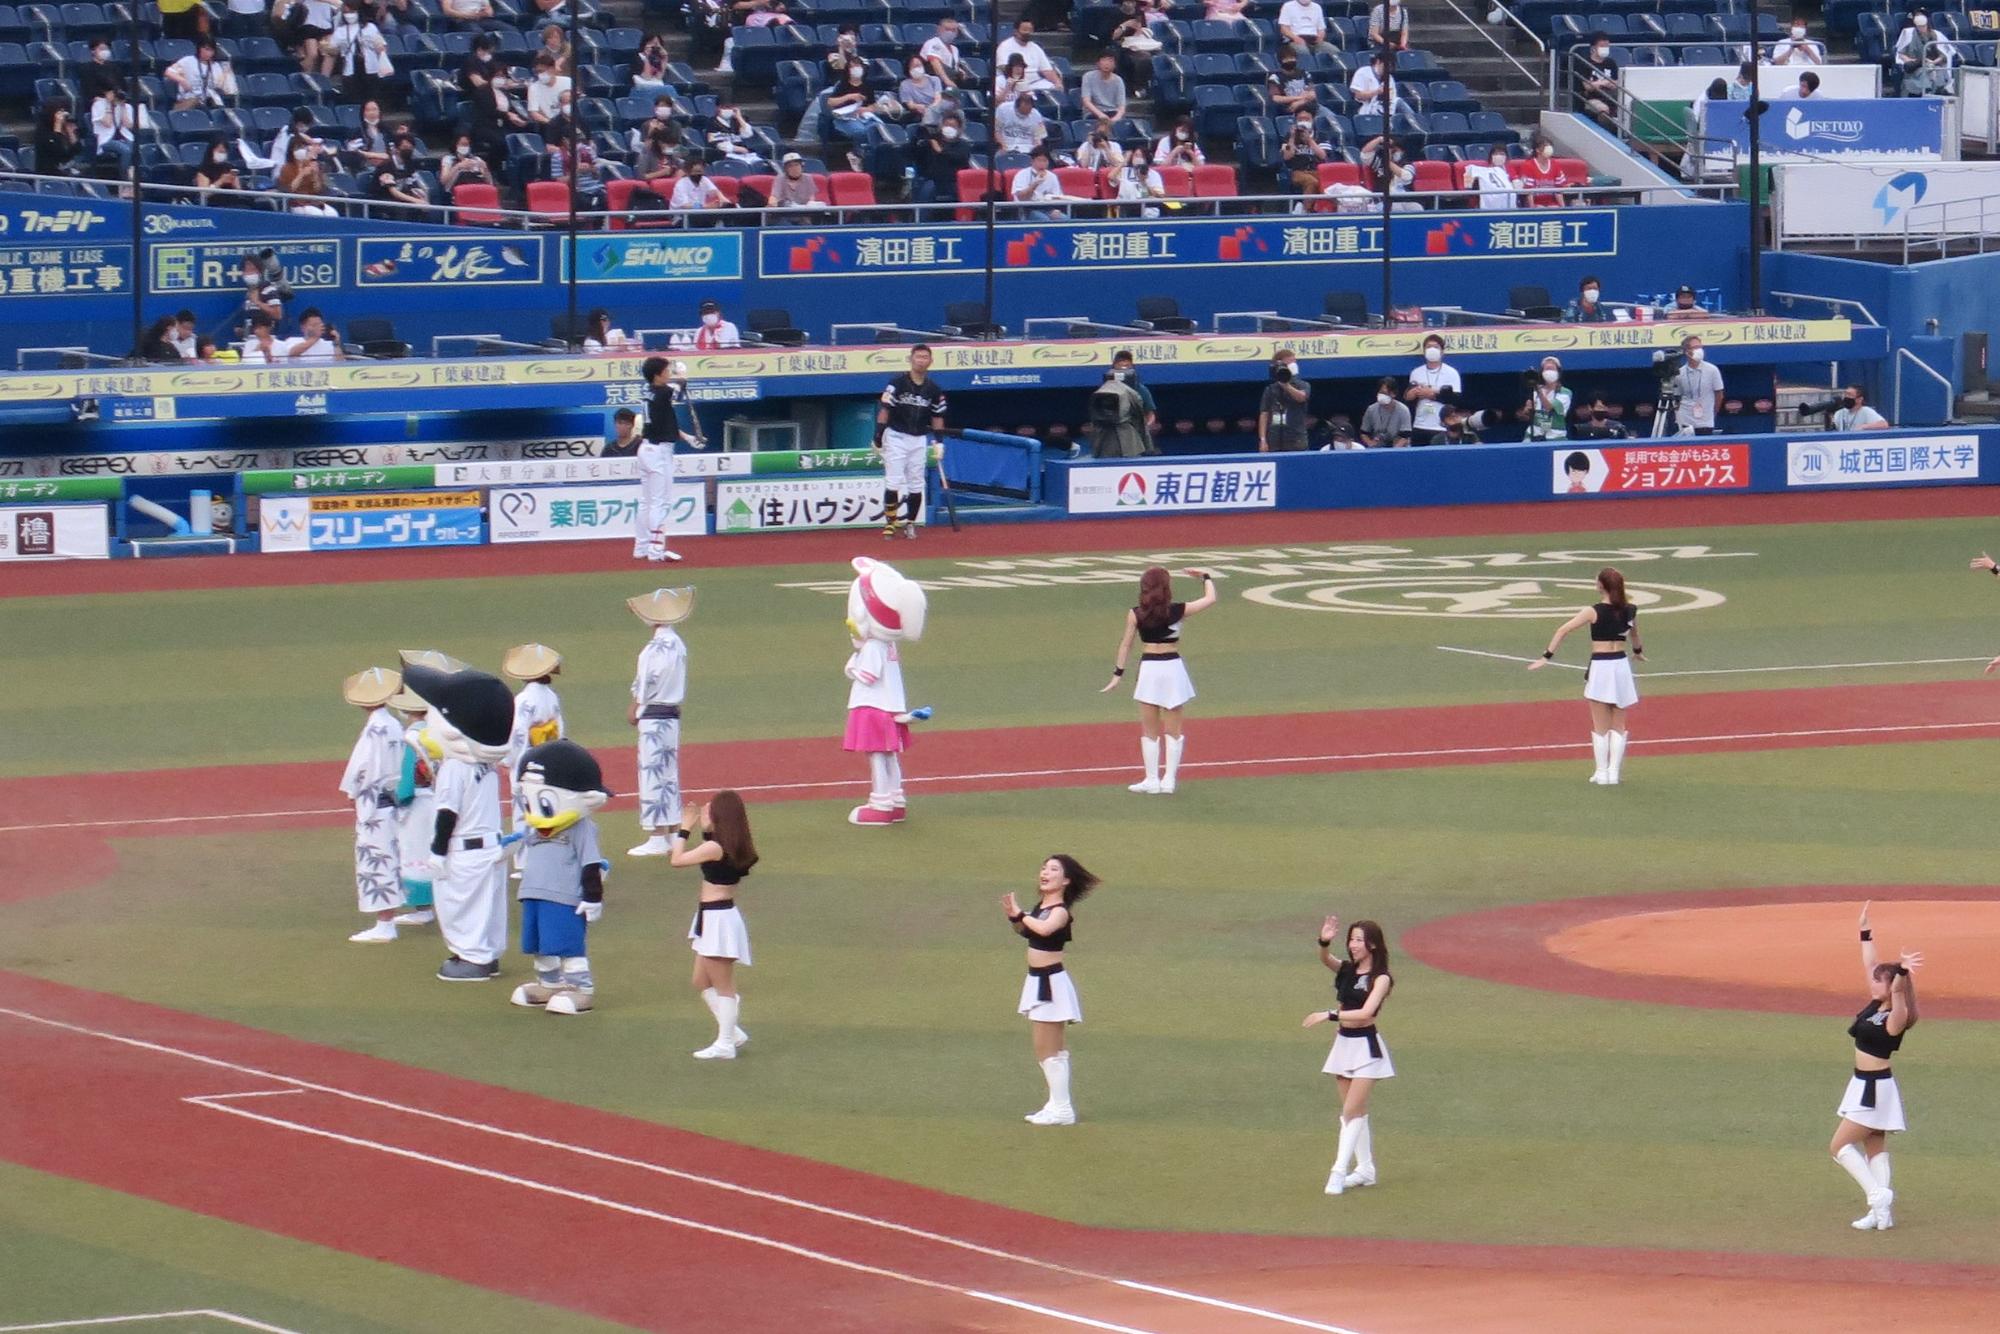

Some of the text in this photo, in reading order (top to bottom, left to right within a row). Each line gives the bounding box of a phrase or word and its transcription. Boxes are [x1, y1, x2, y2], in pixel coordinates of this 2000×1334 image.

[1811, 120, 1864, 133] ISETOYO
[20, 210, 105, 232] ファミリー
[1282, 226, 1385, 256] 濱田重工
[1488, 221, 1588, 249] 濱田重工
[856, 237, 962, 266] 濱田重工
[1072, 231, 1177, 261] 濱田重工
[1586, 329, 1654, 346] 千葉東建設
[1741, 324, 1806, 340] 千葉東建設
[776, 354, 847, 373] 千葉東建設
[943, 349, 1013, 367] 千葉東建設
[254, 370, 330, 388] 千葉東建設
[431, 365, 505, 384] 千葉東建設
[814, 453, 884, 467] レオガーデ
[1624, 448, 1732, 465] 採用でお金がもらえる
[1838, 444, 1974, 474] 城西国際大学
[1621, 463, 1736, 489] ジョブハウス
[1152, 470, 1272, 505] 東日観光
